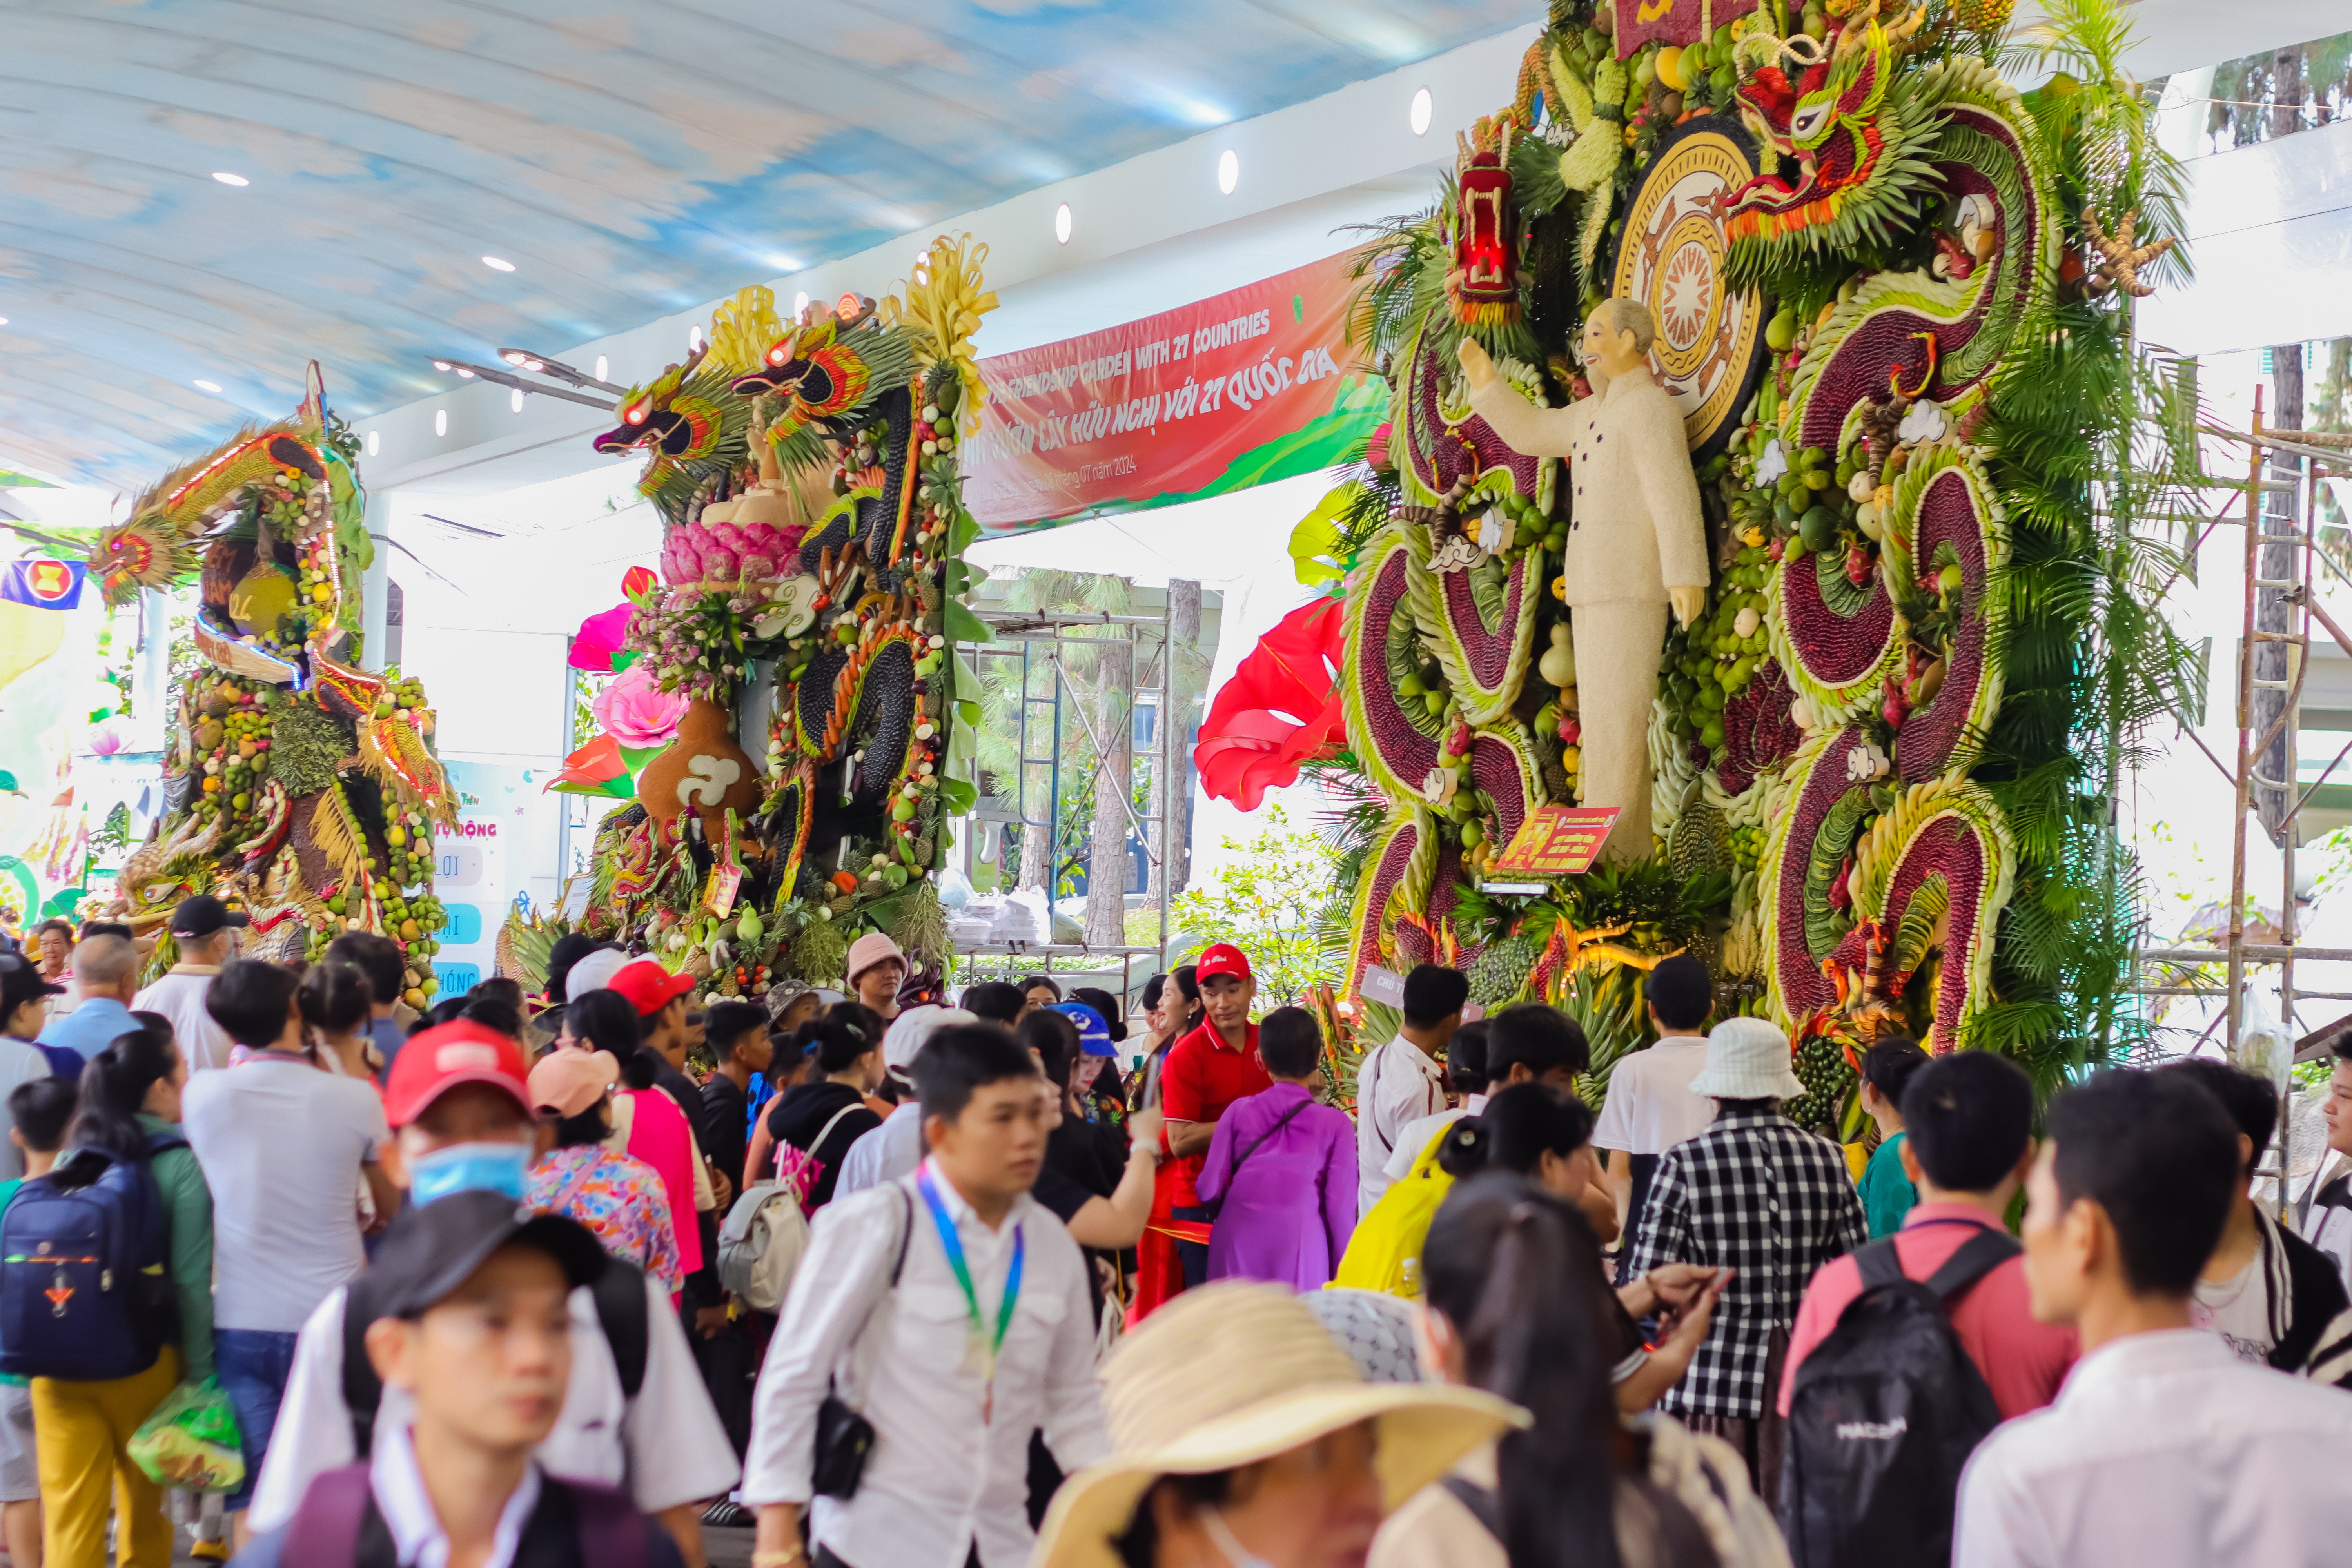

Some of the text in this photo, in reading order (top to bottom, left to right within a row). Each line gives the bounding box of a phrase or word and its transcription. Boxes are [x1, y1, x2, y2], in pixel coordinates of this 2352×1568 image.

[1009, 365, 1078, 398] FRIENDSHIP
[1082, 350, 1132, 385] GARDEN
[1136, 339, 1170, 370] WITH
[1173, 333, 1189, 361] 27
[1193, 309, 1270, 355] COUNTRIES
[1038, 409, 1069, 452] CÂY
[1071, 400, 1111, 444] HỮU
[1111, 393, 1160, 436] NGHỊ
[1164, 376, 1200, 422] VỚI
[1199, 376, 1226, 414] 27
[1227, 346, 1293, 411] QUỐC
[1296, 343, 1340, 385] GIA
[1055, 468, 1080, 489] tháng
[1080, 464, 1092, 483] 07
[1093, 462, 1113, 479] năm
[1114, 454, 1137, 476] 2024
[438, 969, 475, 993] HÓNG
[1377, 975, 1395, 990] CHỦ
